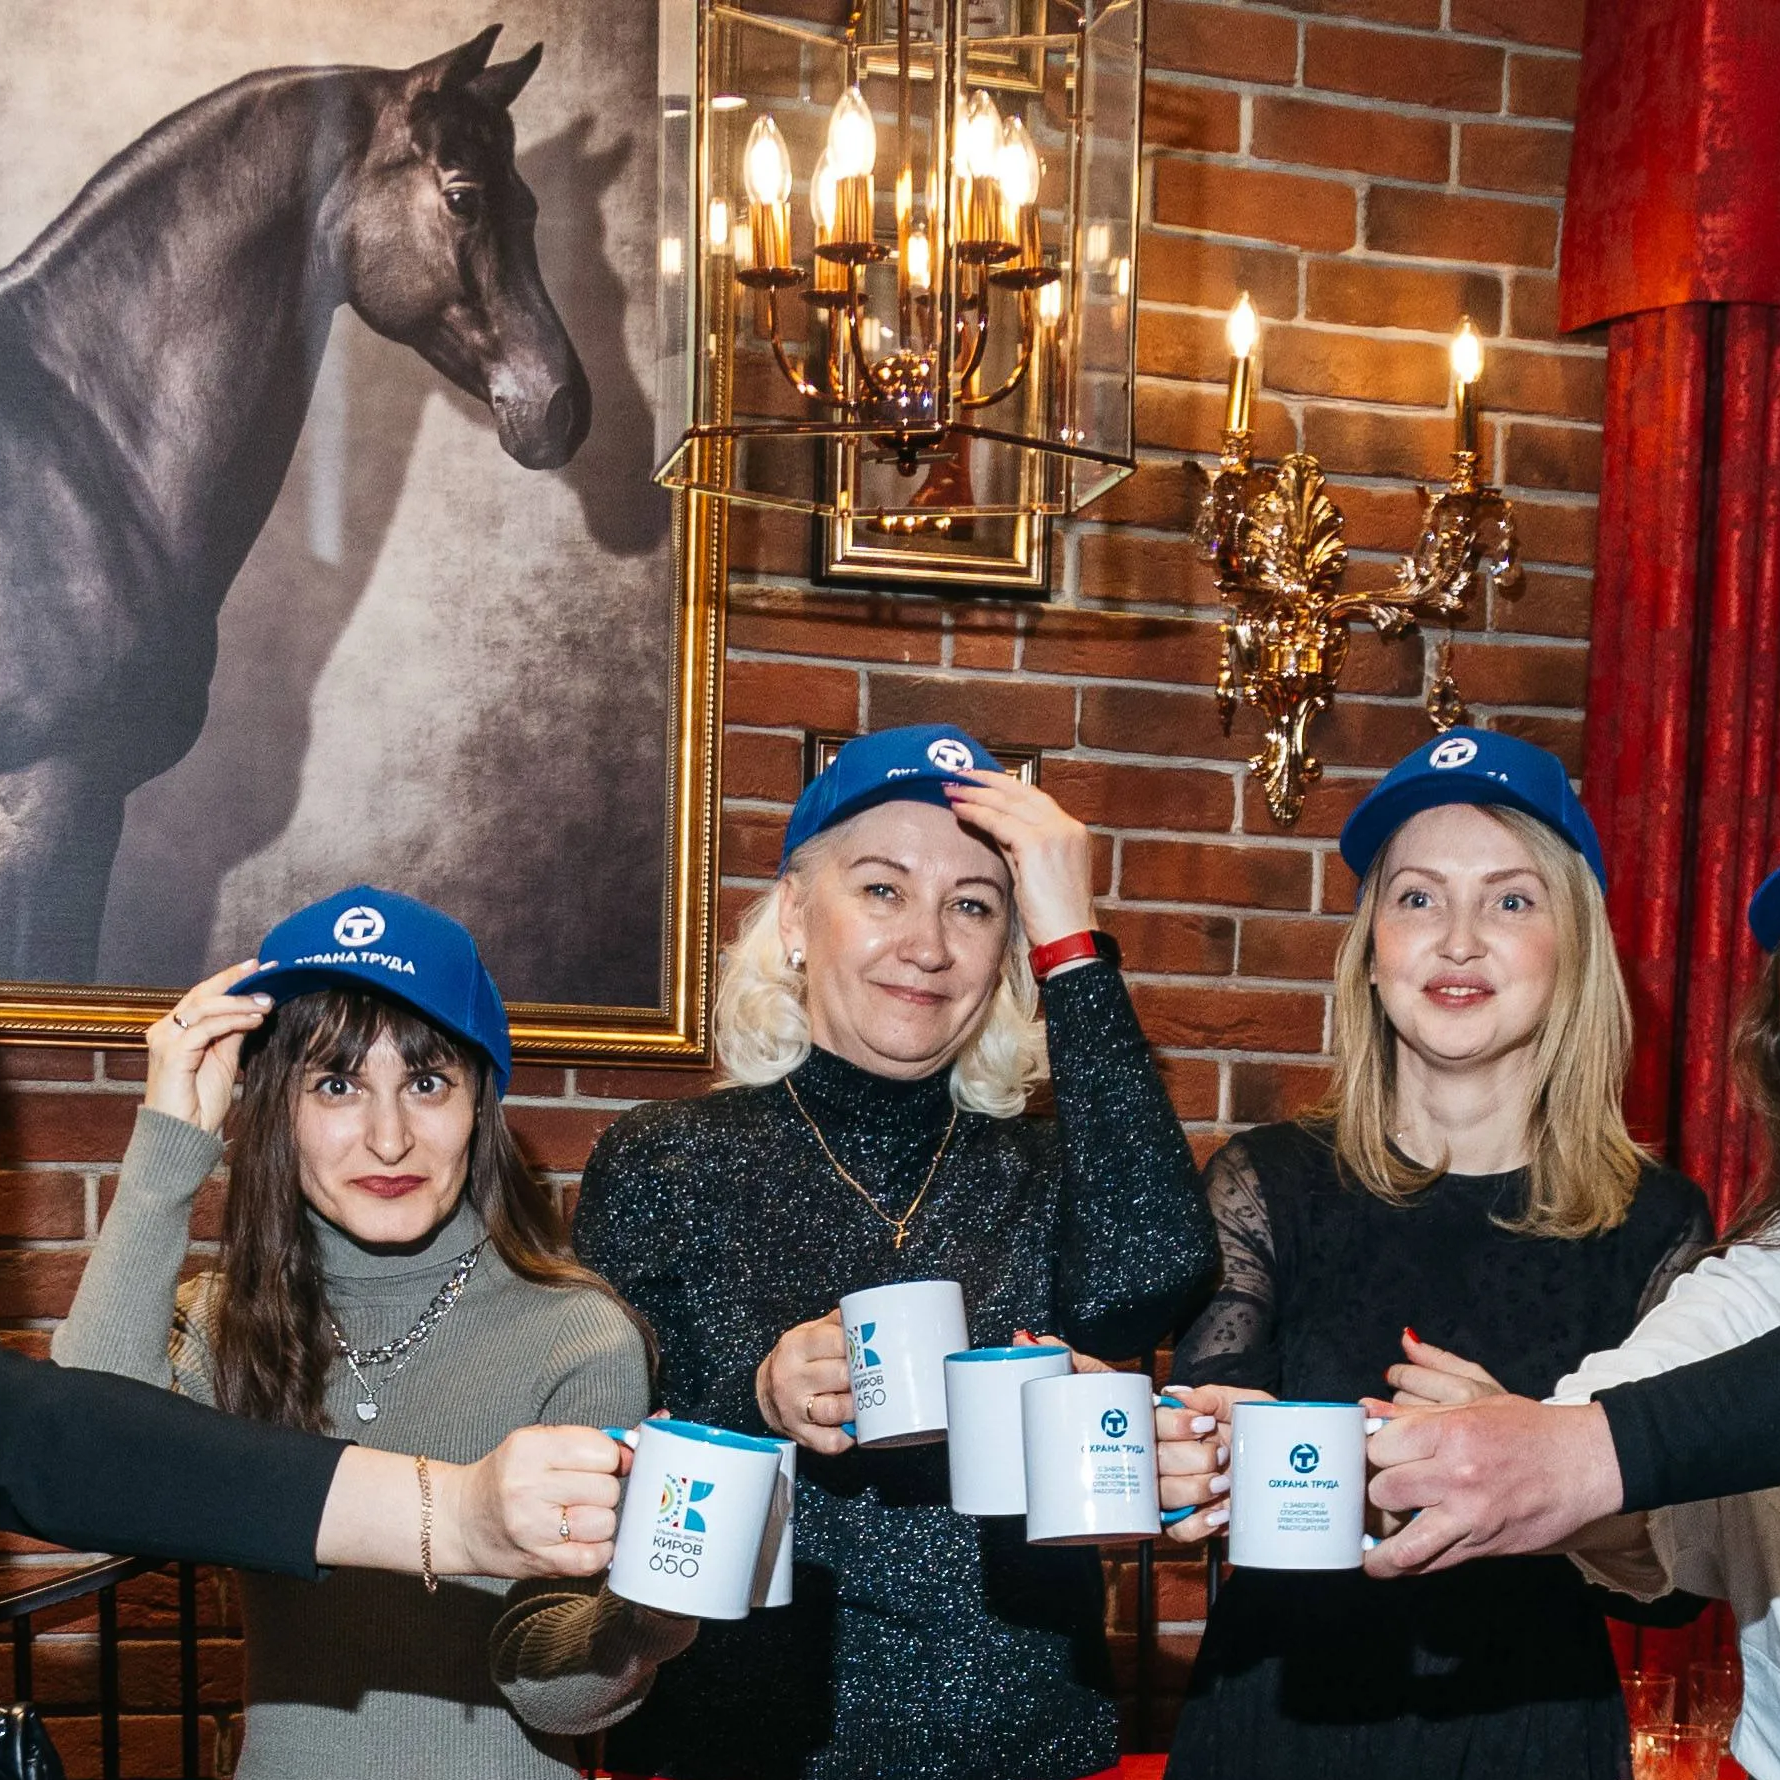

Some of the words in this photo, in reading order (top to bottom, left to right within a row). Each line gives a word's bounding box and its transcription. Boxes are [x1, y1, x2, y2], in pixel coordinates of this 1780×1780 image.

[360, 951, 416, 975] ТРУДА
[1080, 1445, 1120, 1453] ХРАНА
[1268, 1480, 1309, 1488] ОХРАНА
[1311, 1480, 1340, 1489] ТРУДА
[652, 1535, 703, 1556] КИРОВ
[649, 1552, 699, 1578] 650
